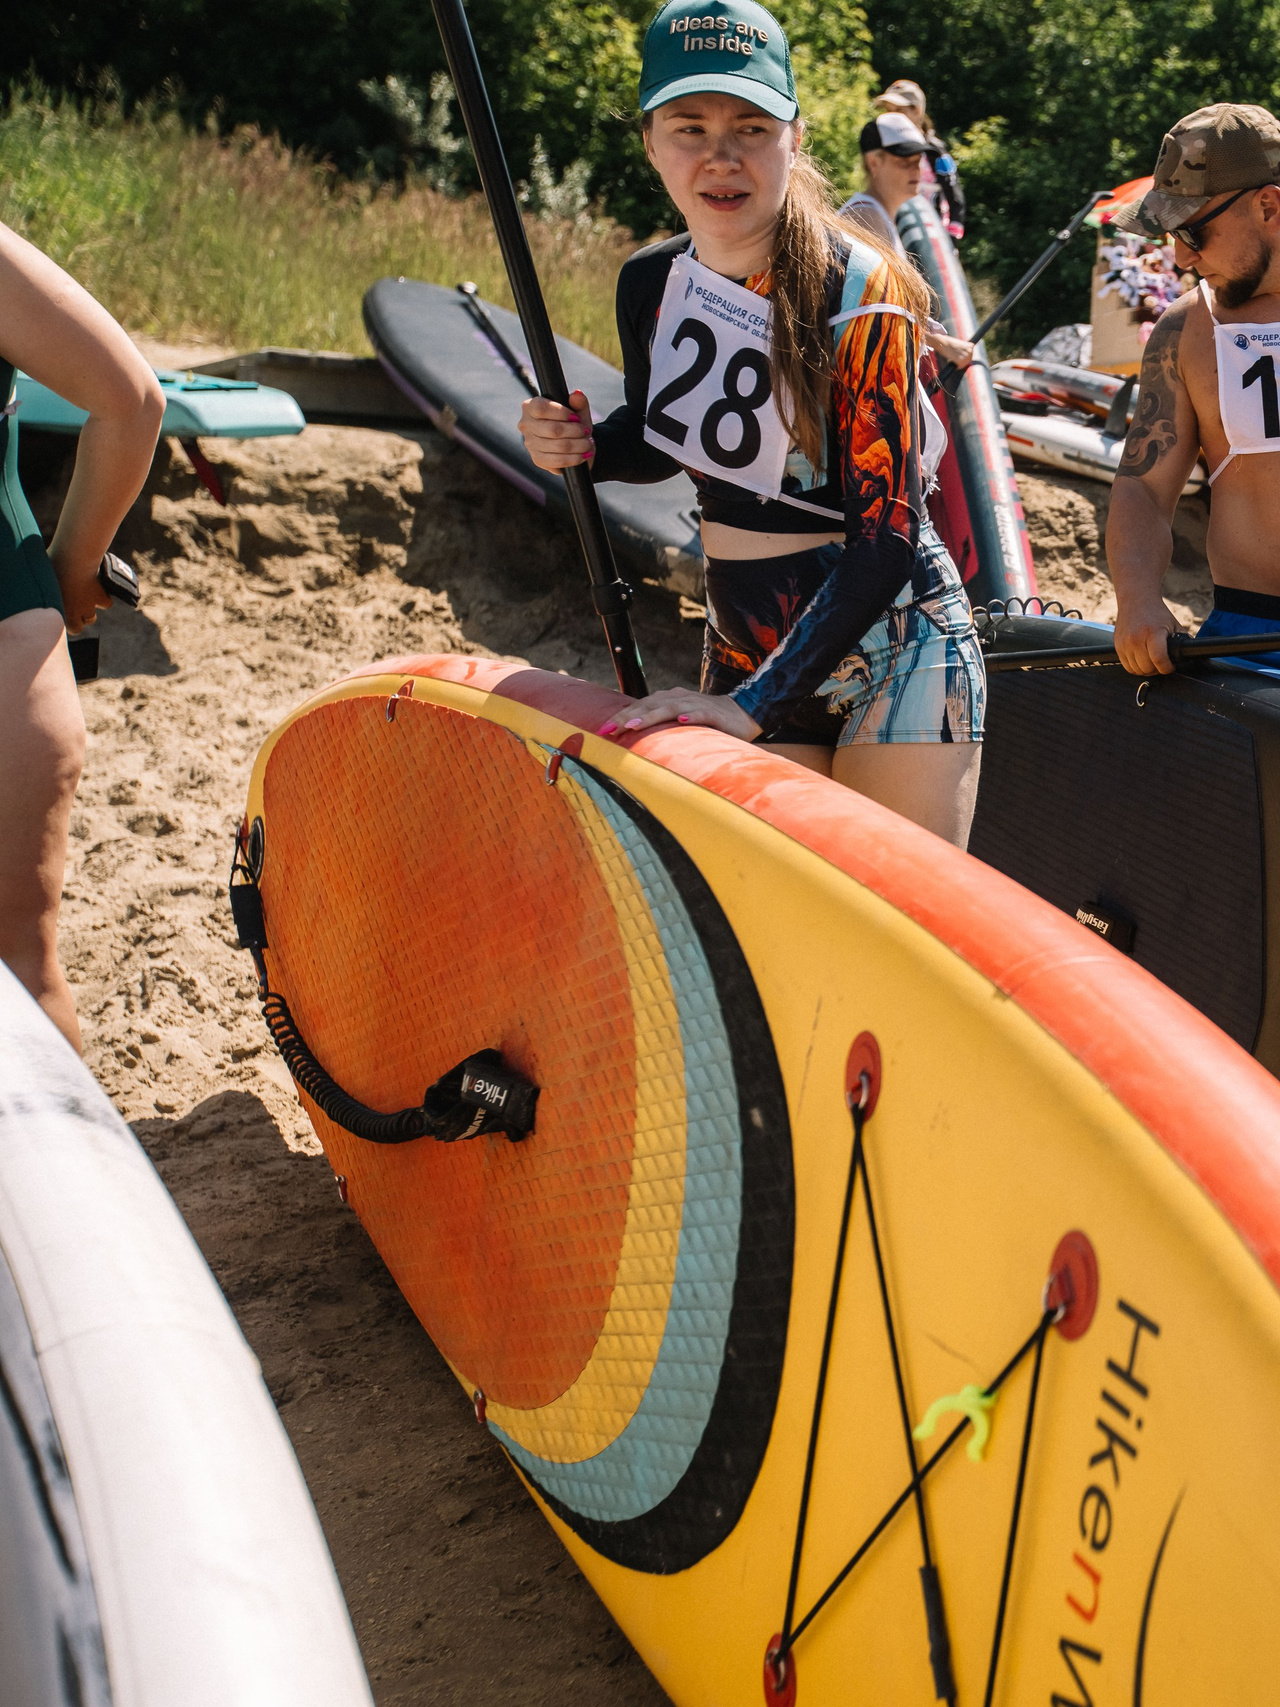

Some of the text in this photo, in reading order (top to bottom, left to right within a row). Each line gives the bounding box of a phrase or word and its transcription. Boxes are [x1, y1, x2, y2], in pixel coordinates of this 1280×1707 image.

[669, 15, 769, 43] ideas are
[683, 33, 753, 56] inside
[695, 286, 748, 319] ФЕДЕРАЦИЯ
[701, 302, 750, 332] НОВОСИБИРСКОЙ
[647, 317, 772, 469] 28
